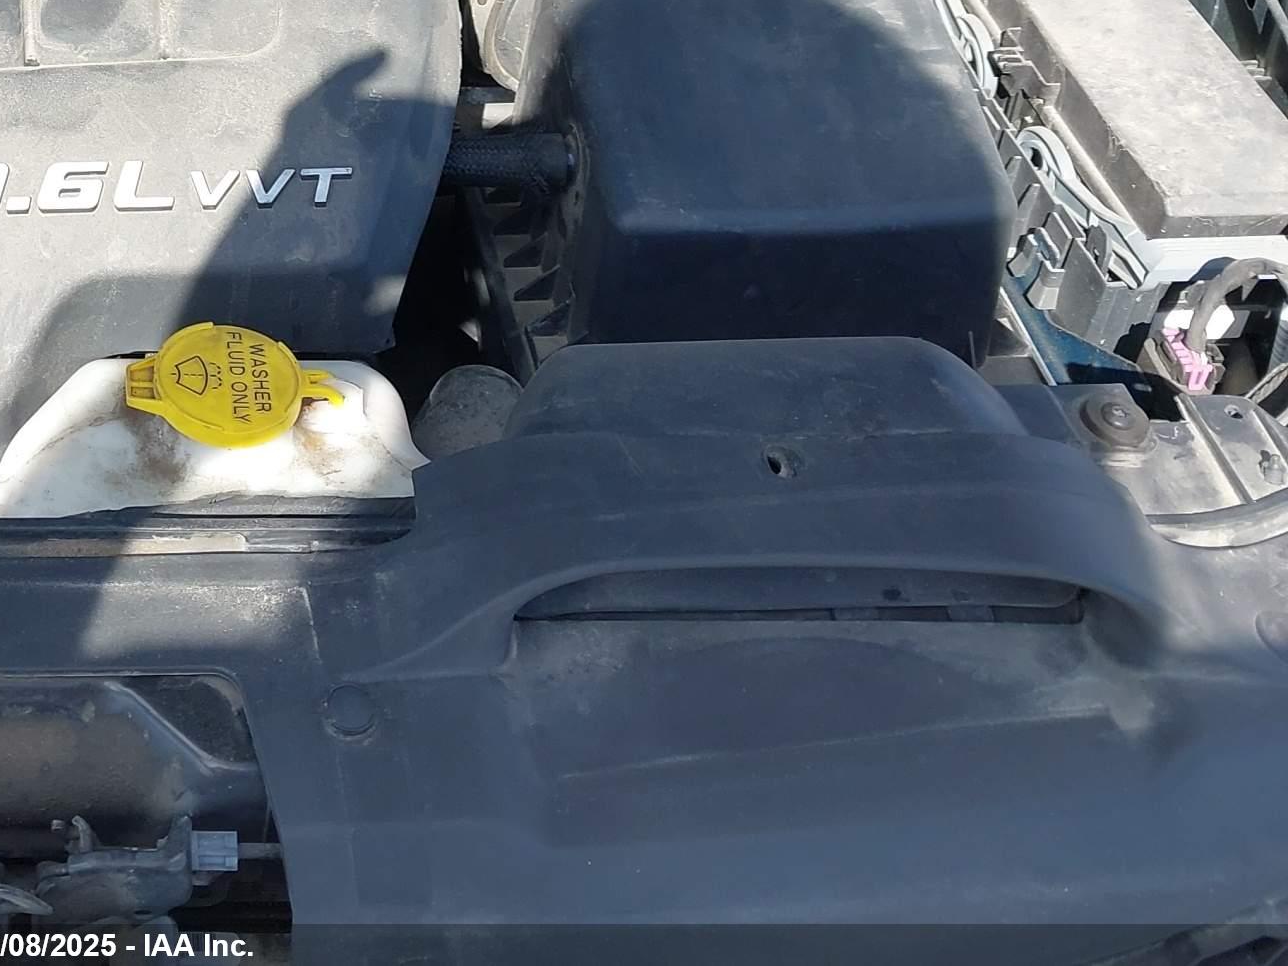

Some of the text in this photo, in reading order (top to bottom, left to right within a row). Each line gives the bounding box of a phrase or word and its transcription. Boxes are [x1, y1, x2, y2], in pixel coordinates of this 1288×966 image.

[190, 166, 354, 210] VVT
[226, 331, 253, 425] FLUID ONLY
[249, 343, 272, 412] WASHER
